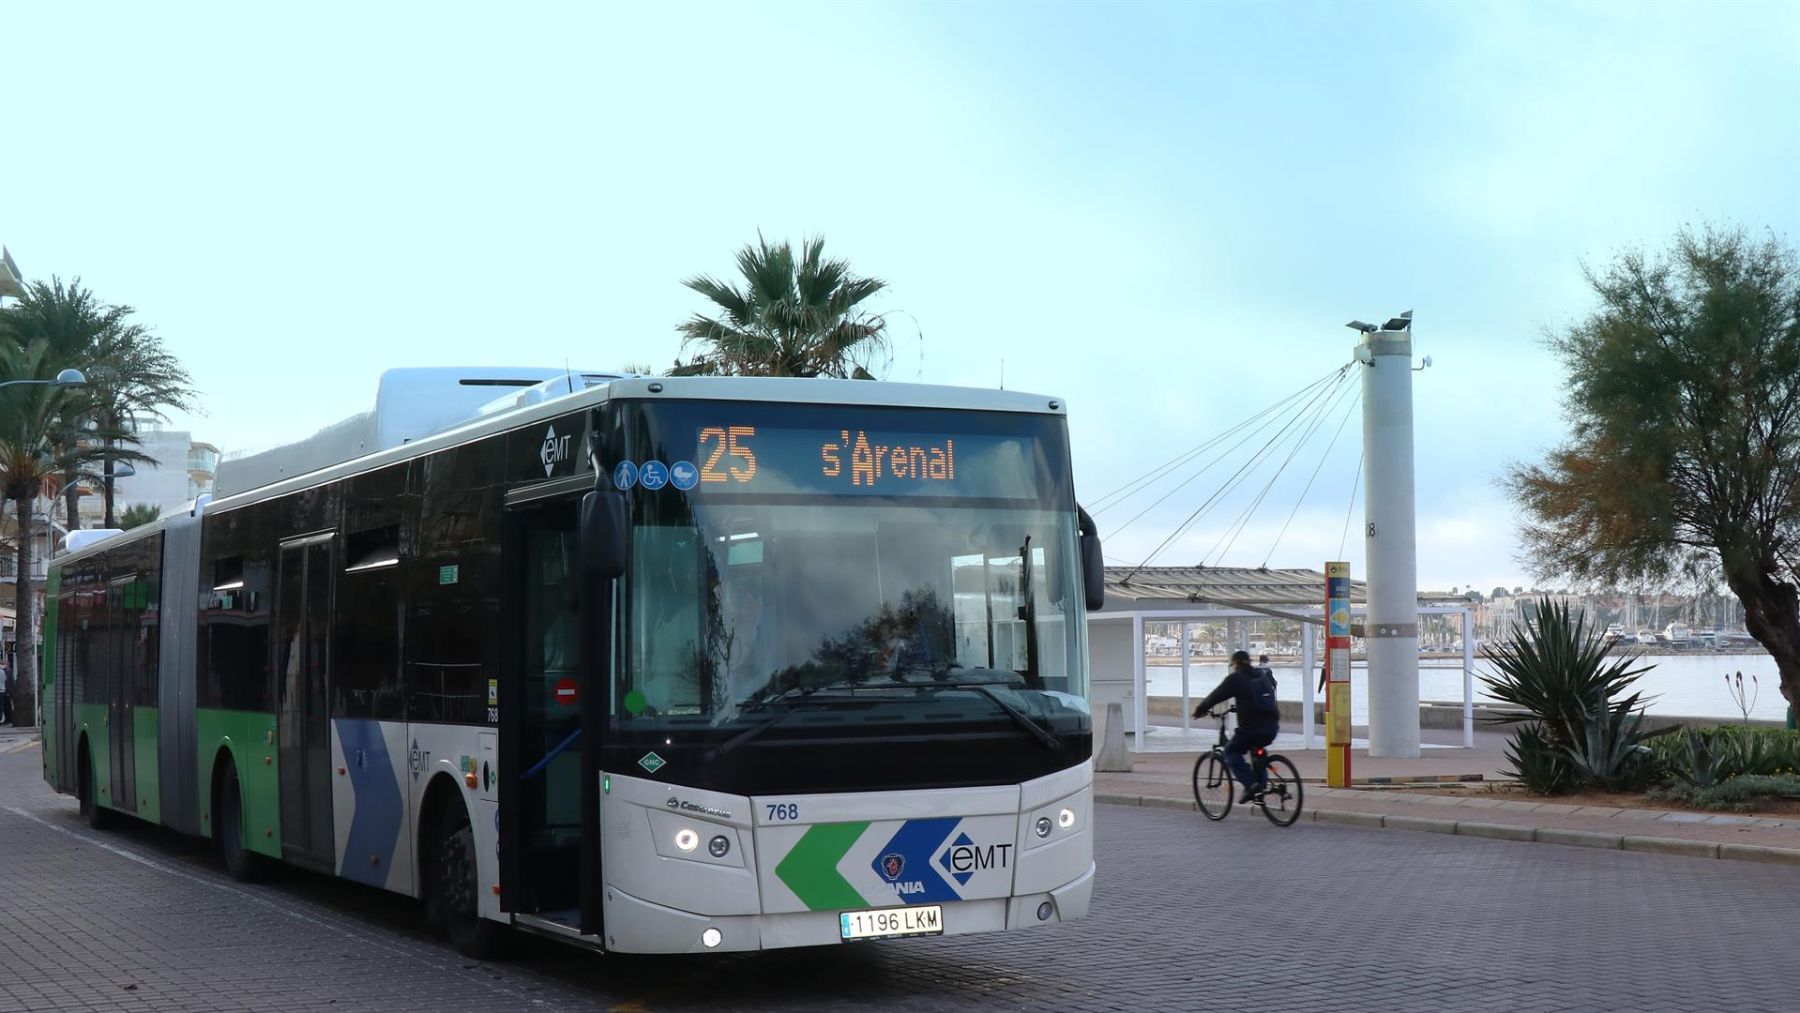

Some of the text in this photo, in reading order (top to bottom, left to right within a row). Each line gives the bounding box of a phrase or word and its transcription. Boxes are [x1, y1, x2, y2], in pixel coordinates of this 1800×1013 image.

[700, 426, 954, 486] 25 s'Arenal
[487, 708, 499, 723] 768
[766, 803, 798, 820] 768
[864, 881, 925, 895] ANIA
[855, 914, 899, 933] 1196
[905, 910, 938, 929] LKM
